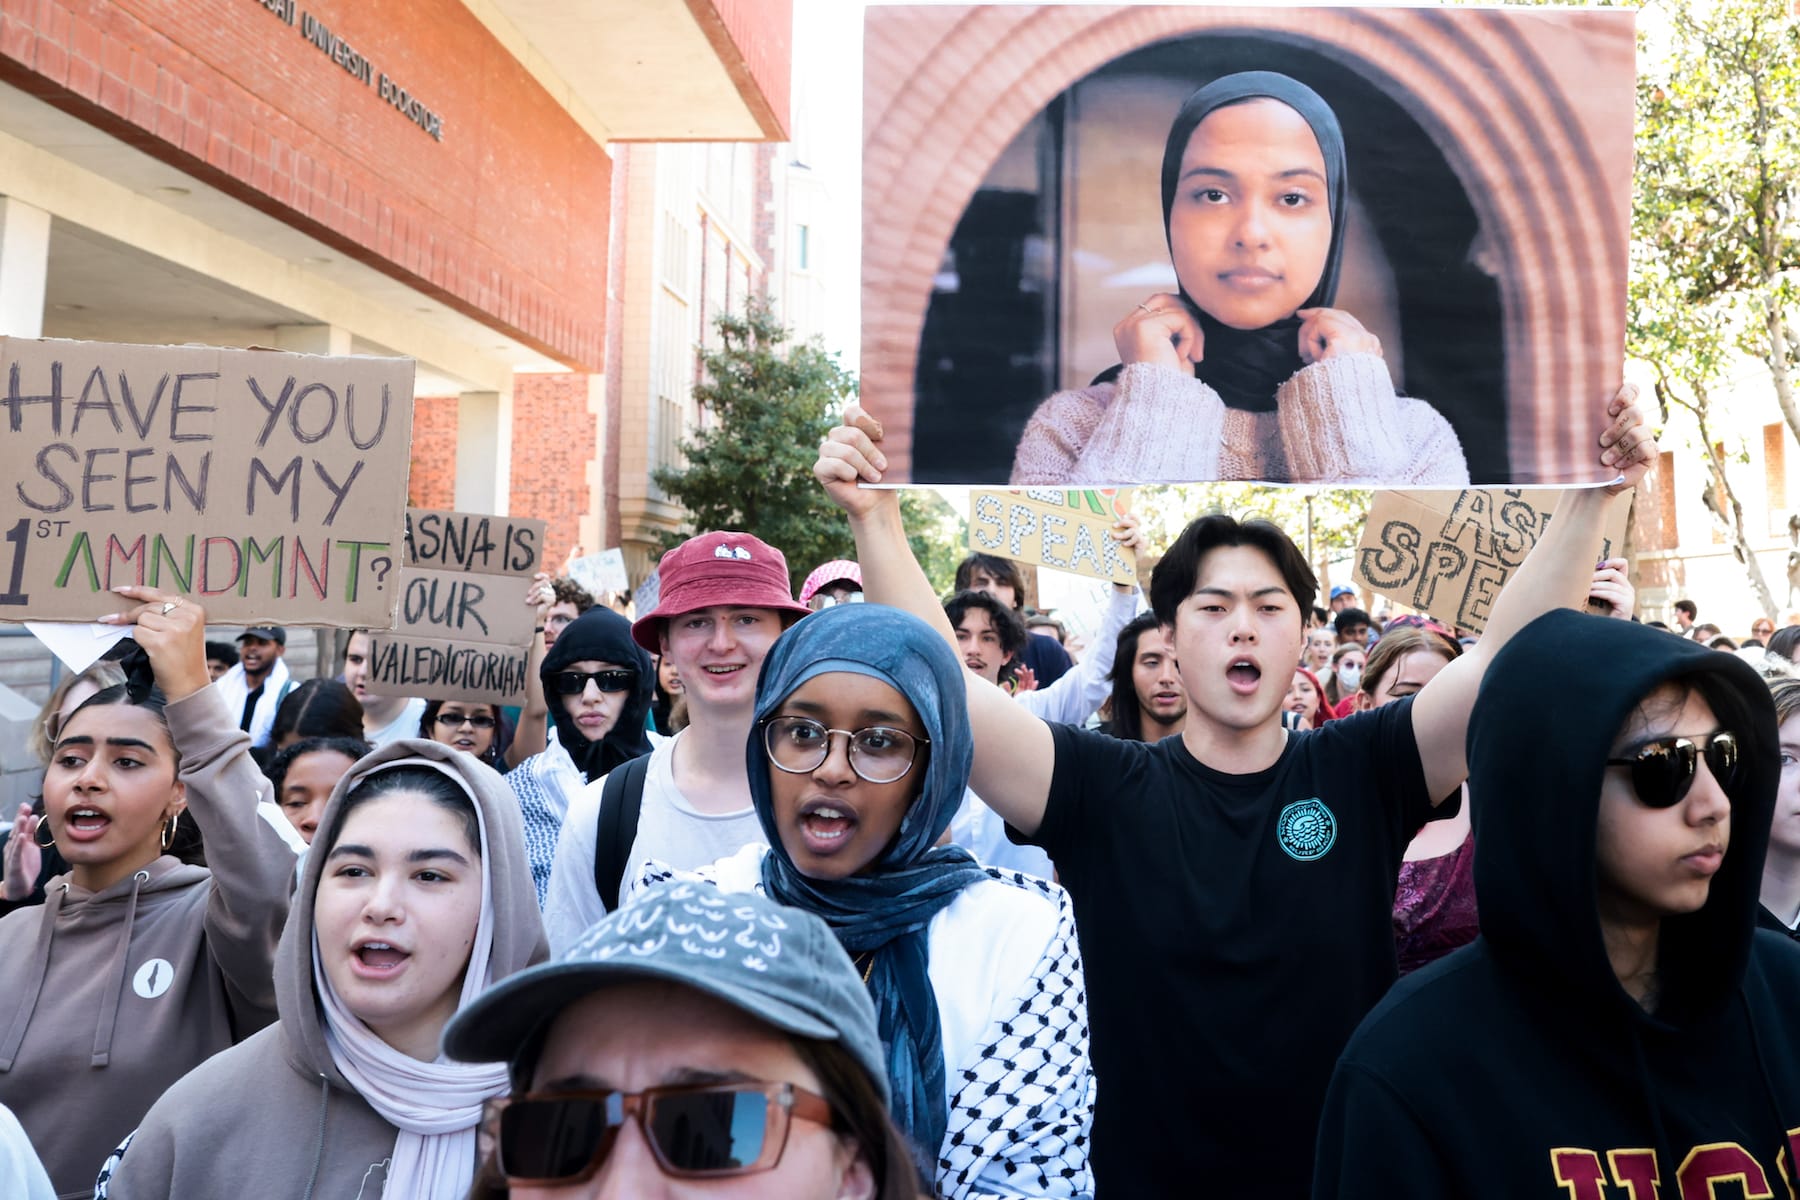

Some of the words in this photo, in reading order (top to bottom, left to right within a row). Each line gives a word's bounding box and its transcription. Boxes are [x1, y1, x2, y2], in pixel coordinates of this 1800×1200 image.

[302, 11, 374, 86] UNIVERSITY
[378, 73, 444, 142] BOOKSTORE
[2, 361, 221, 442] HAVE
[246, 374, 391, 450] YOU
[16, 443, 213, 514] SEEN
[246, 455, 365, 526] MY
[503, 523, 535, 572] IS
[975, 494, 1134, 577] SPEAK
[404, 577, 489, 636] OUR
[372, 639, 529, 697] VALEDICTORIAN
